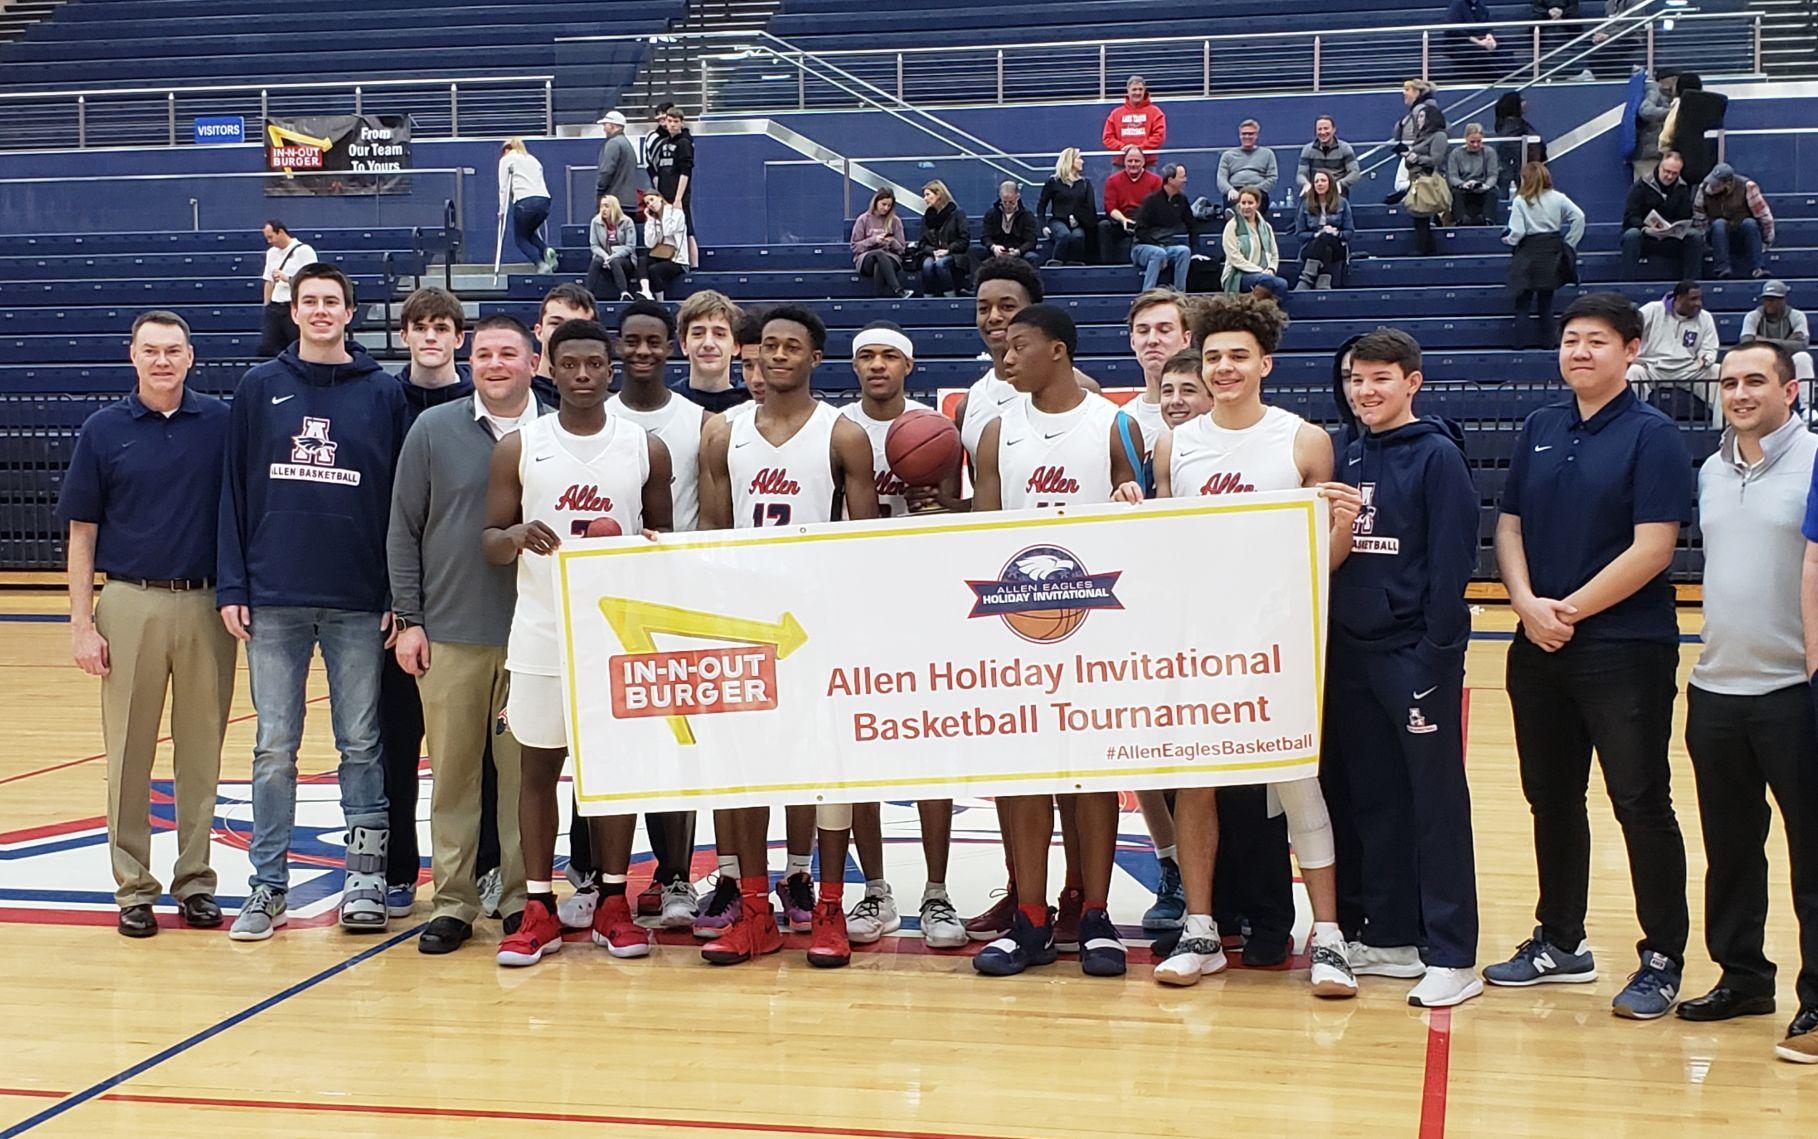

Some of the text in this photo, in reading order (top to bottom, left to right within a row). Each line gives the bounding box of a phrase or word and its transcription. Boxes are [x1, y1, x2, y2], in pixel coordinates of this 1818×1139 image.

[197, 124, 240, 136] VISITORS
[361, 127, 391, 140] From
[273, 147, 320, 158] IN-N-OUT
[349, 144, 403, 157] Our Team
[273, 157, 320, 167] BURGER
[351, 161, 400, 171] To Yours
[299, 468, 358, 483] BASKETBALL
[749, 468, 801, 495] Allen
[1025, 466, 1080, 494] Allen
[554, 484, 614, 512] Allen
[996, 581, 1093, 594] ALLEN EAGLES
[983, 588, 1110, 605] HOLIDAY INVITATIONAL
[623, 654, 766, 685] IN-N-OUT
[826, 644, 1282, 697] Allen Holiday Invitational
[624, 680, 768, 710] BURGER
[854, 696, 1271, 742] Basketball Tournament
[1106, 734, 1313, 761] #AllenEaglesBasketball
